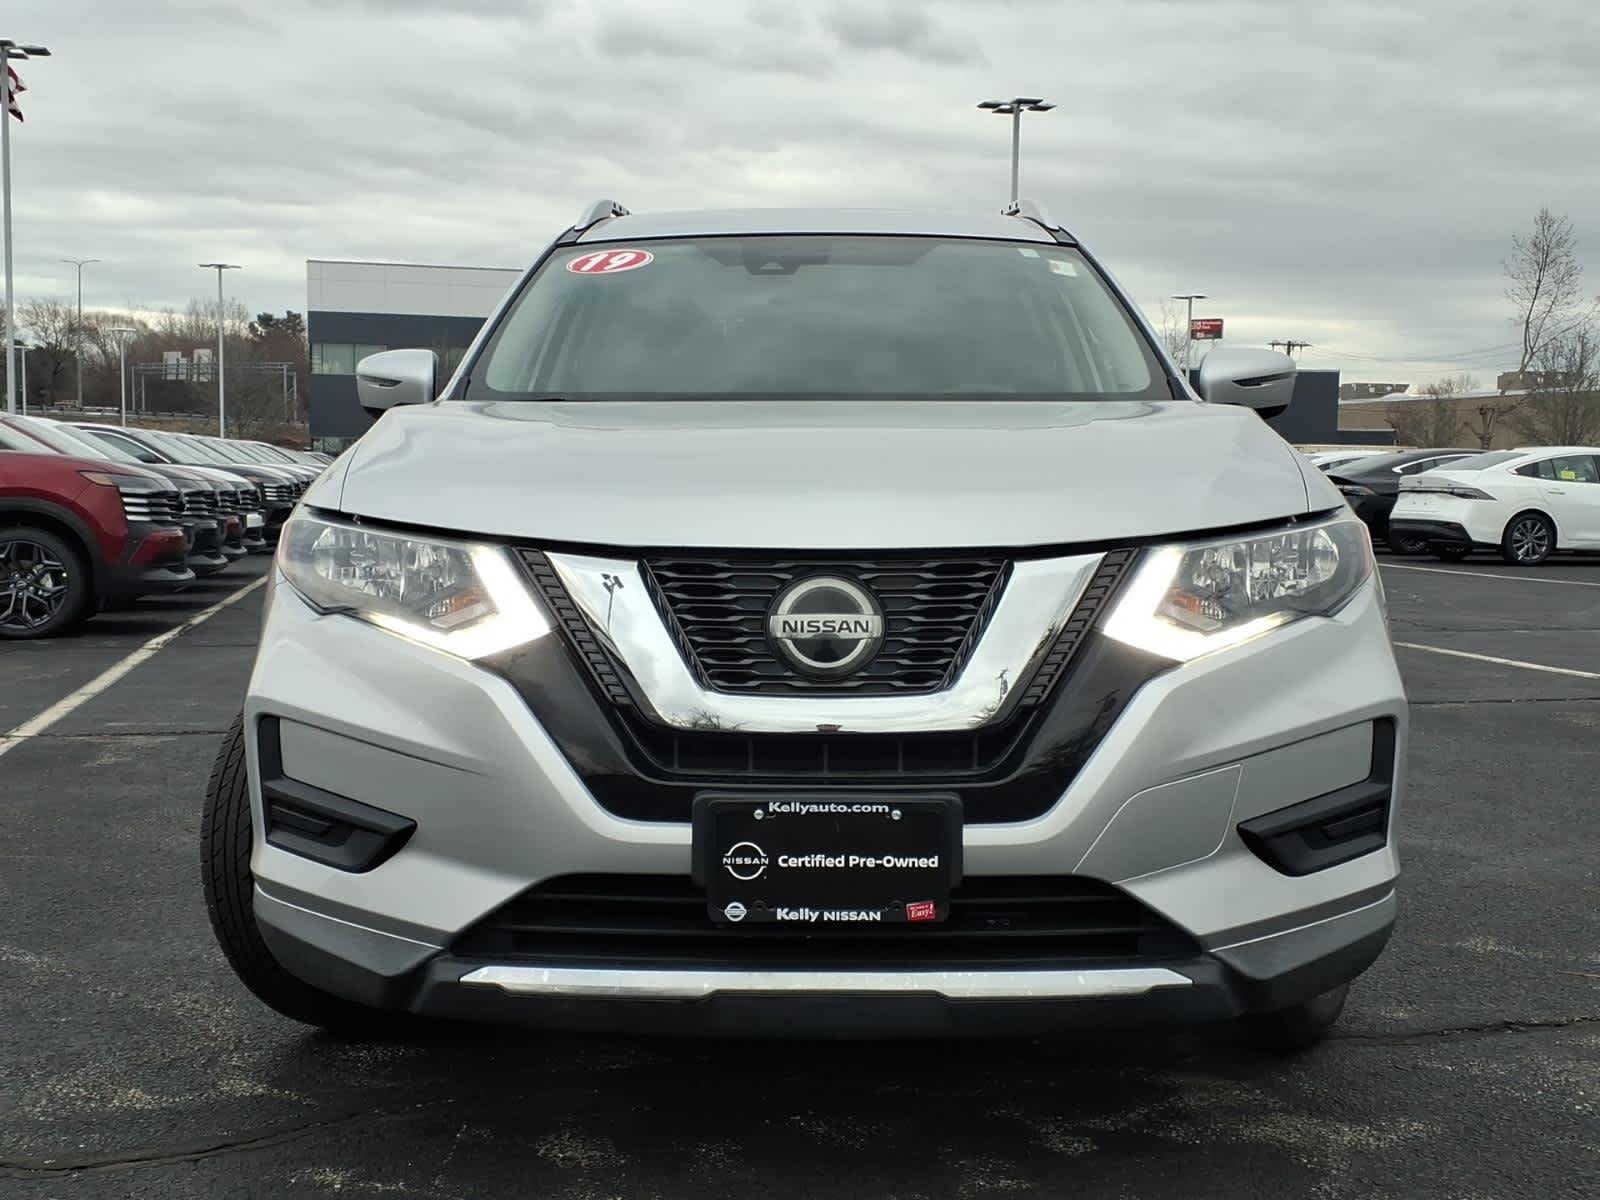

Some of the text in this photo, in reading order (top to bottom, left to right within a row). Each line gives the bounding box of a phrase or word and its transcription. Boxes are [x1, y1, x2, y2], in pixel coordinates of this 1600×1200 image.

[579, 252, 637, 271] 19
[782, 620, 869, 633] NISSAN
[768, 802, 889, 815] Kellyauto.com
[723, 857, 769, 865] NISSAN
[778, 854, 939, 868] Certified Pre-Owned
[776, 907, 881, 922] Kelly NISSAN
